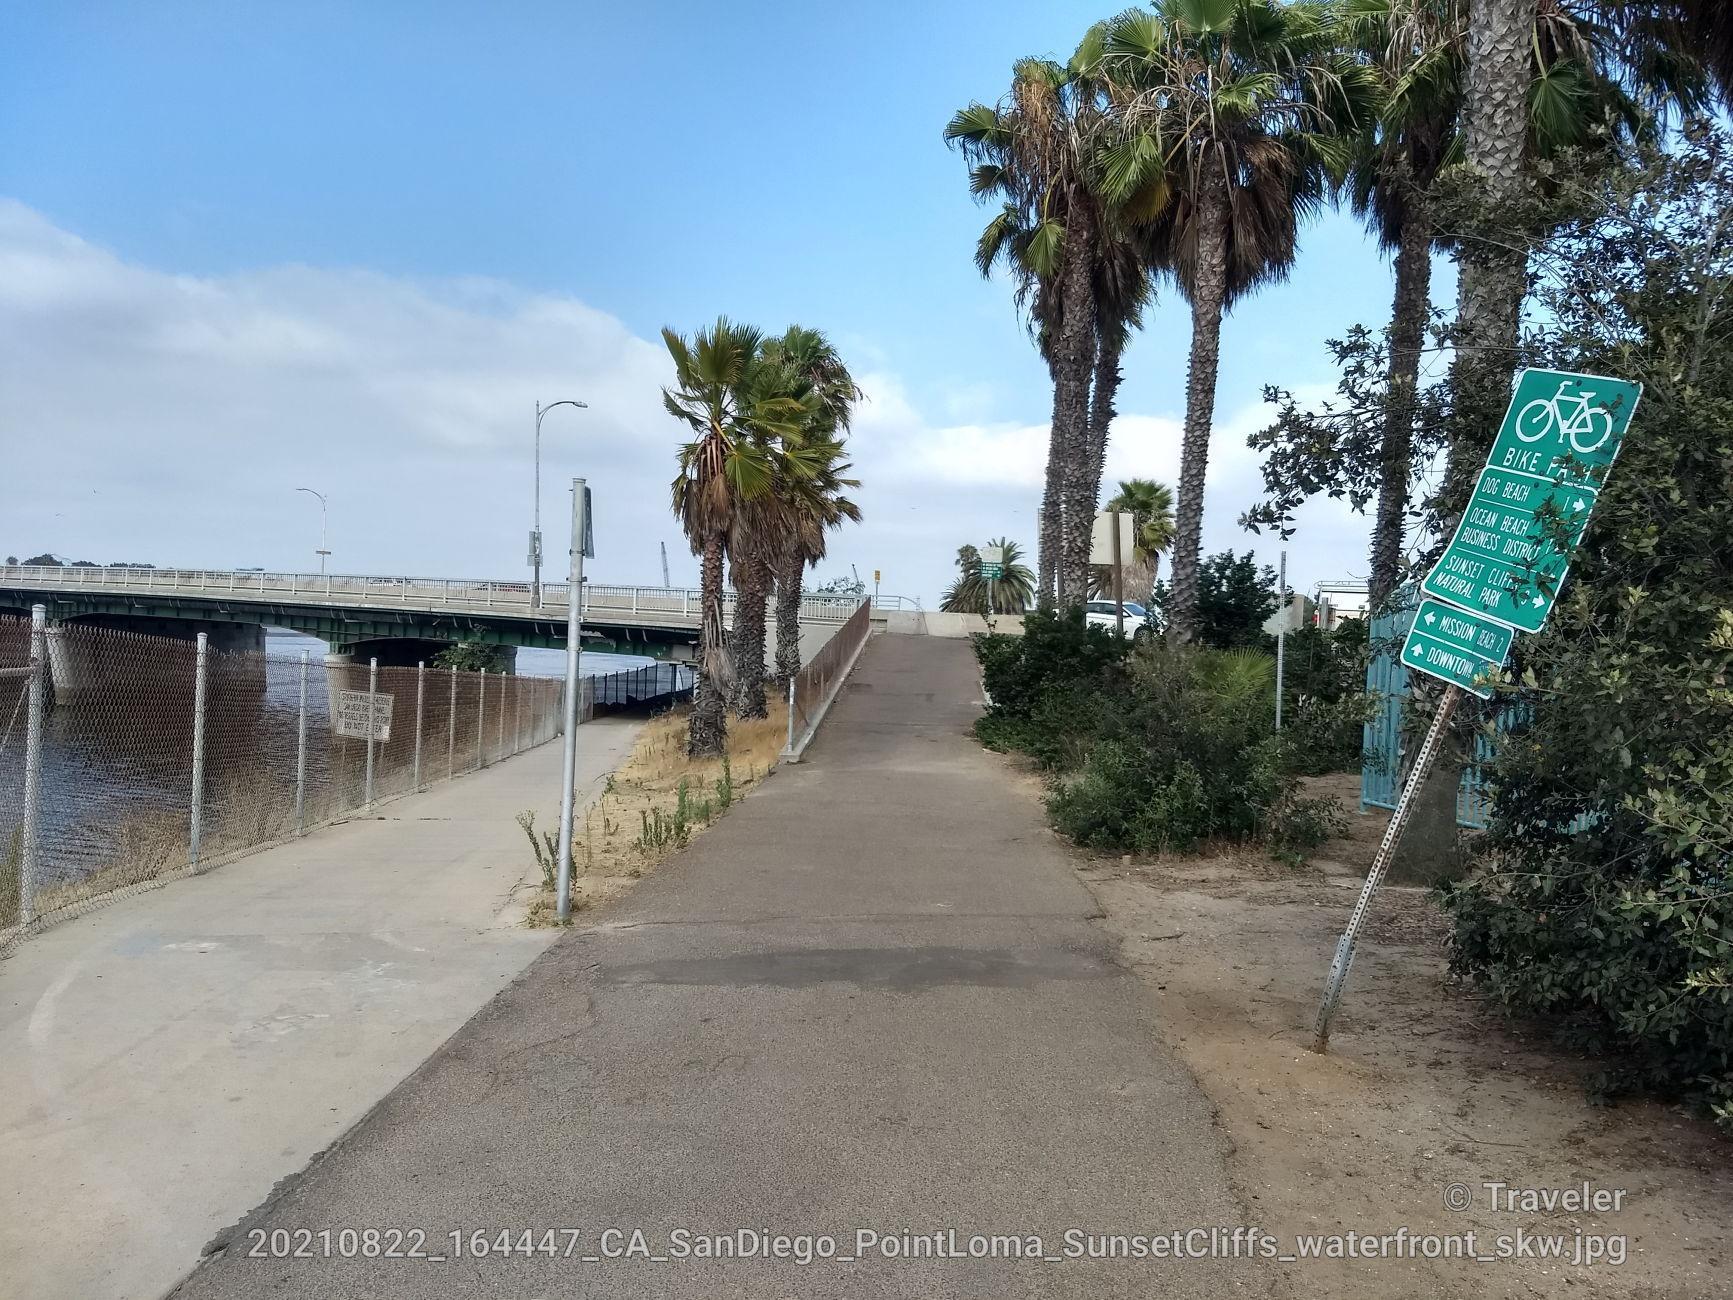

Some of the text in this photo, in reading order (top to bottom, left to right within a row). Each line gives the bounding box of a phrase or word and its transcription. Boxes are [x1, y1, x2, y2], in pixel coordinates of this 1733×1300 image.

[1503, 448, 1542, 472] BIKE
[1481, 477, 1501, 495] DOG
[1502, 482, 1531, 502] BEACH
[1469, 507, 1531, 536] OCEAN BEACH
[1460, 526, 1501, 551] BUSINESS
[1502, 538, 1541, 562] DISTRICT
[1444, 555, 1518, 591] SUNSET CLIFF
[1432, 572, 1476, 599] NATURAL
[1478, 587, 1503, 608] PARK
[1438, 615, 1477, 642] MISSION
[1476, 629, 1497, 650] BEACH
[1426, 647, 1475, 678] DOWNTOWN
[344, 721, 382, 733] DO NOT ETER
